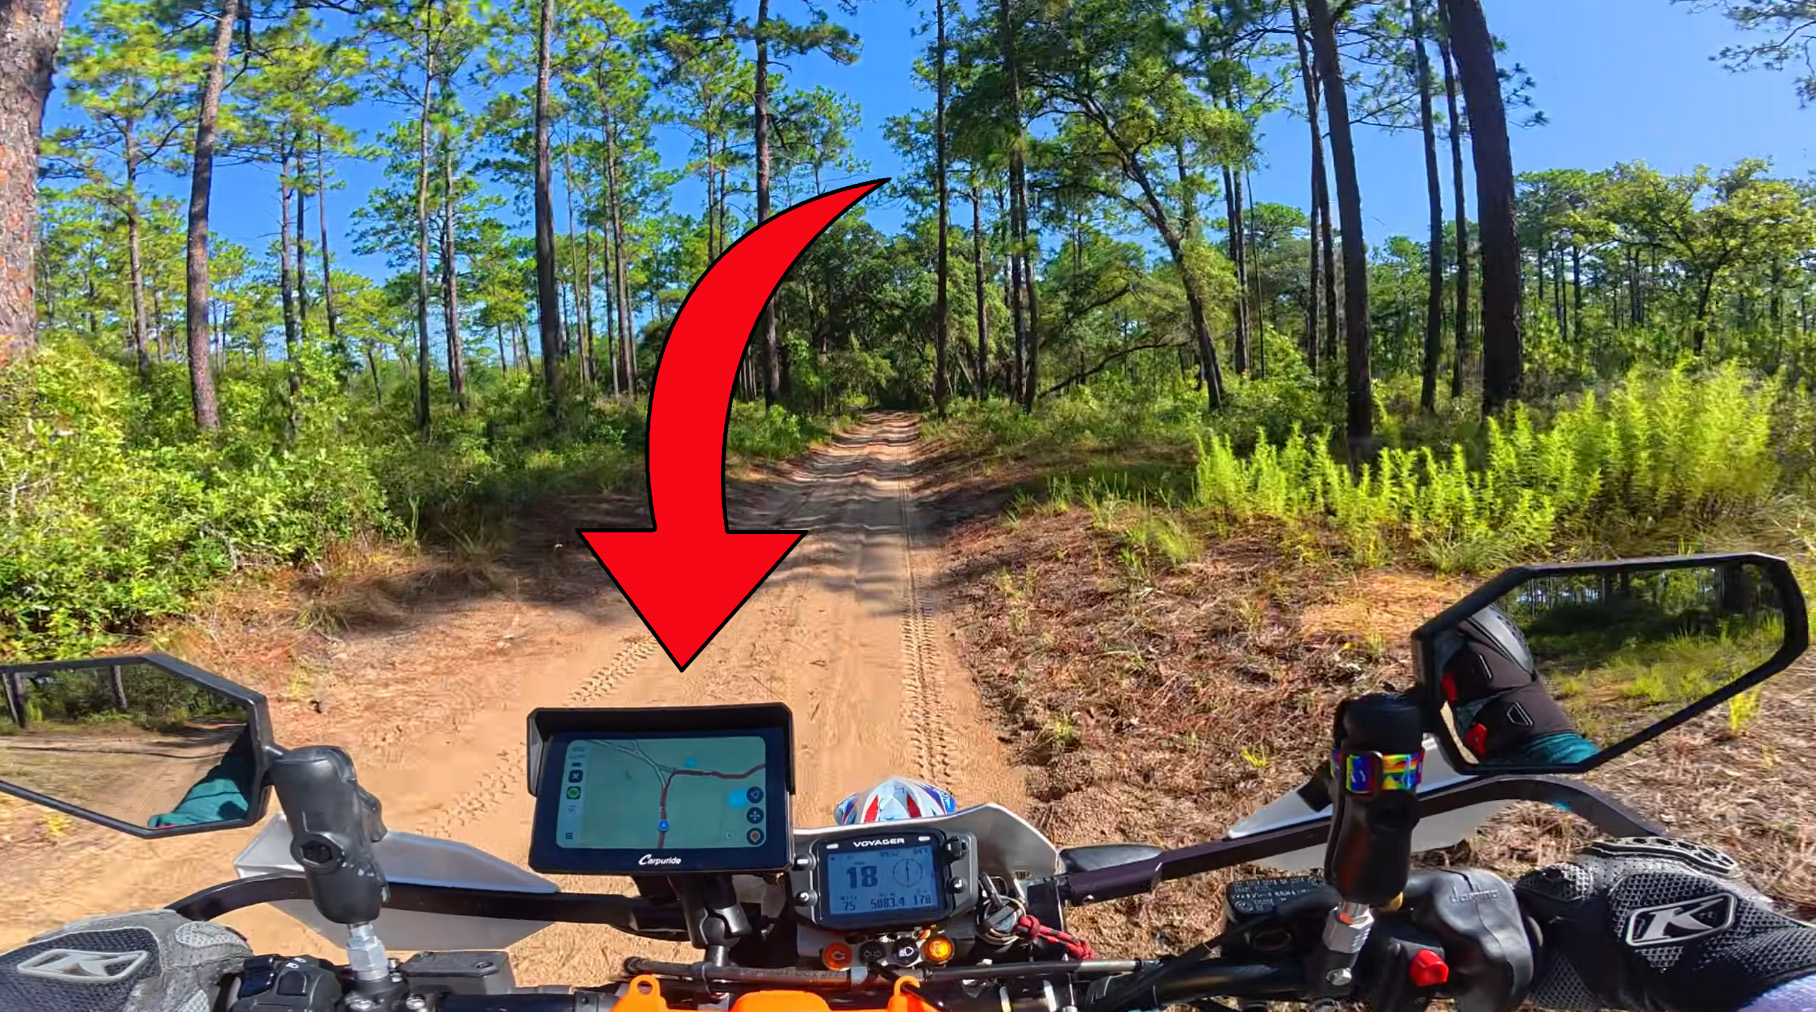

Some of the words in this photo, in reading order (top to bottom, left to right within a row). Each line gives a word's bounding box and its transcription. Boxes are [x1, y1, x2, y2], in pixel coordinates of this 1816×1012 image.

[853, 837, 905, 848] VOYAGER
[638, 854, 682, 866] Carpuride
[846, 865, 878, 889] 18
[843, 900, 856, 911] 75
